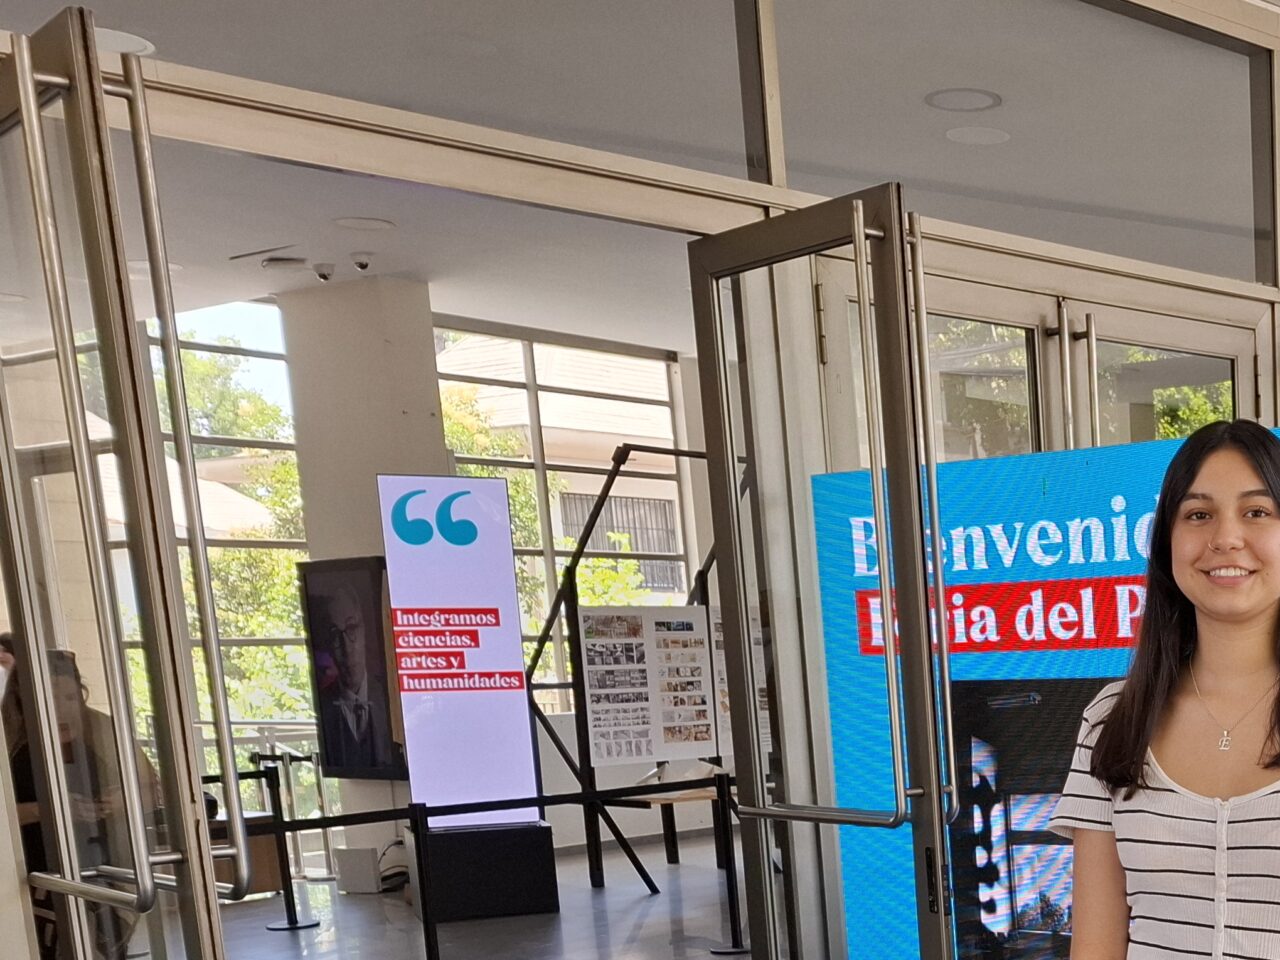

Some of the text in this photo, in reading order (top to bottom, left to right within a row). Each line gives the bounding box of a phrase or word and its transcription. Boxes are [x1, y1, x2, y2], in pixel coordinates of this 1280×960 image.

[396, 610, 496, 628] Integramos
[1015, 587, 1097, 641] del
[398, 631, 475, 647] ciencias,
[401, 654, 460, 672] artes y
[402, 673, 520, 690] humanidades
